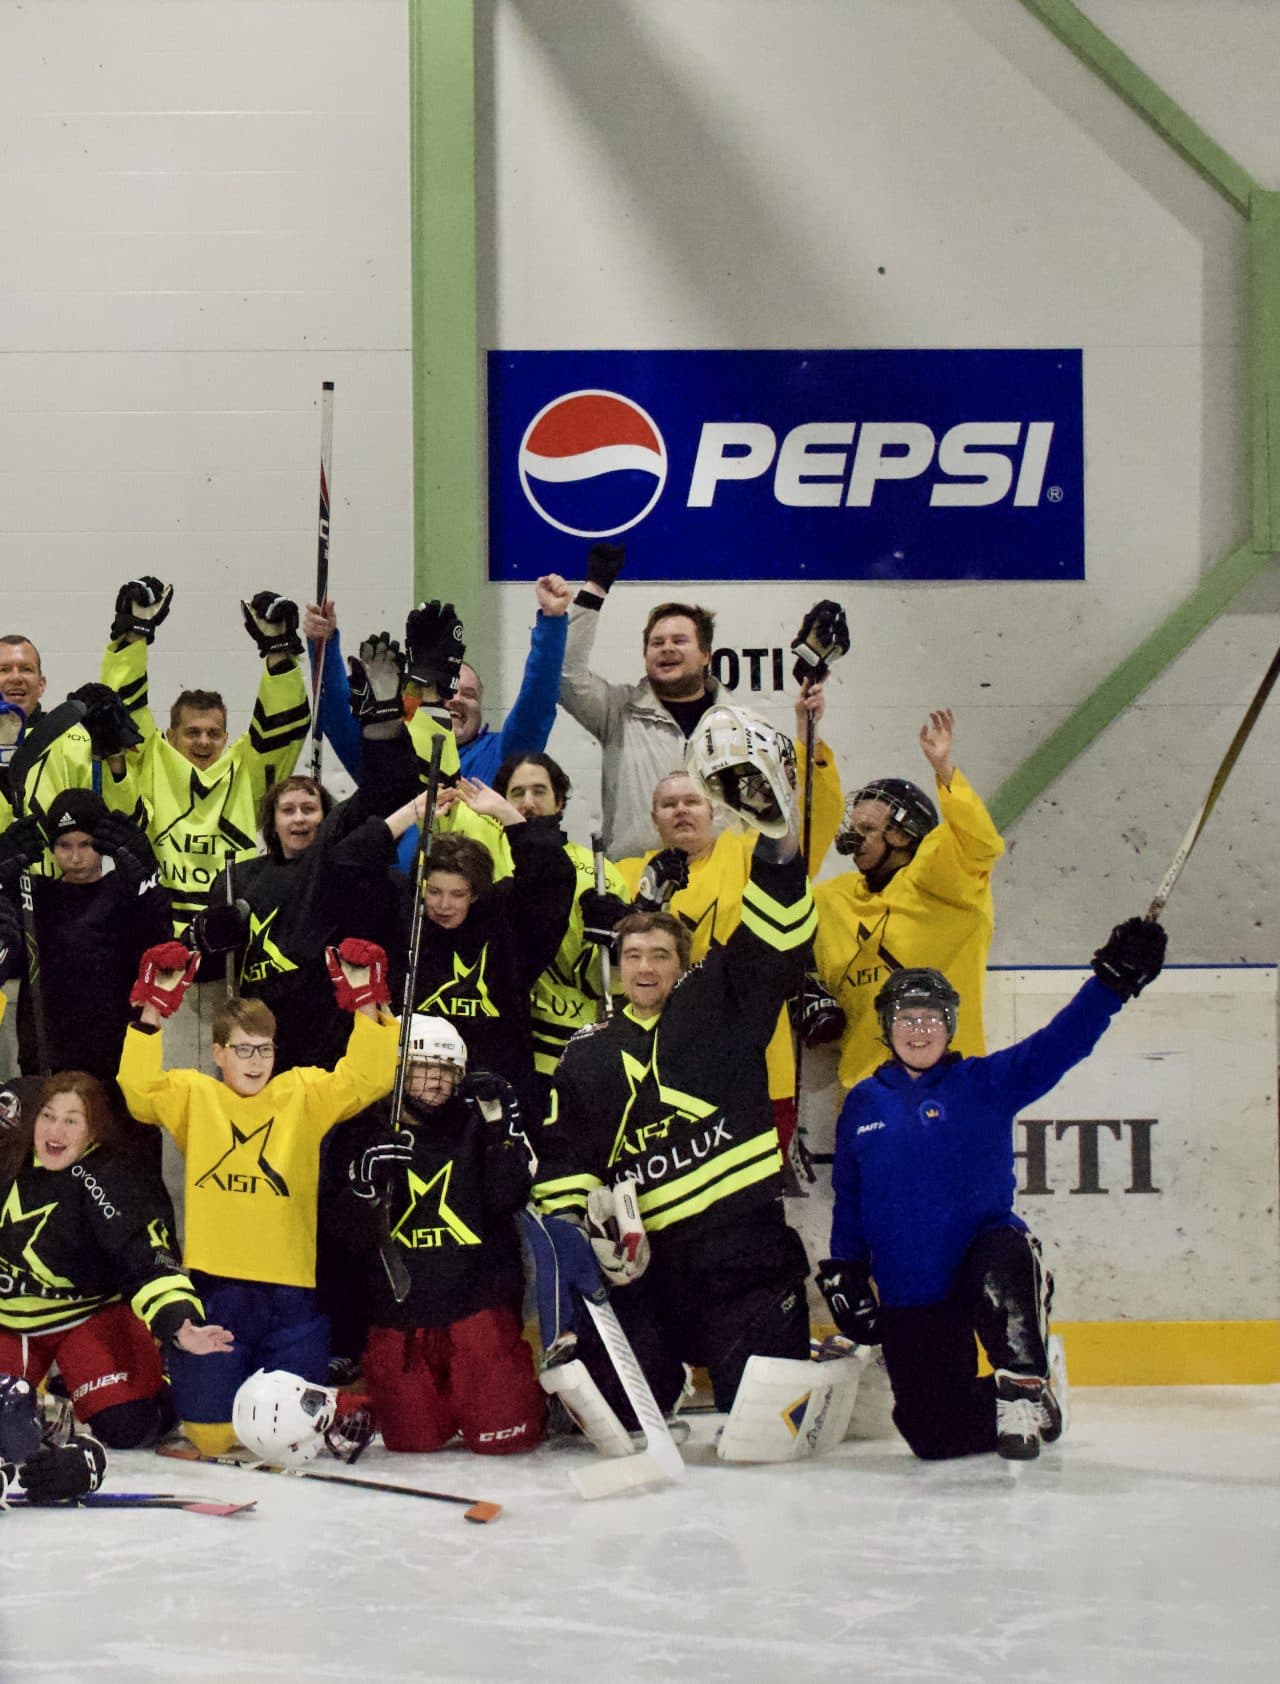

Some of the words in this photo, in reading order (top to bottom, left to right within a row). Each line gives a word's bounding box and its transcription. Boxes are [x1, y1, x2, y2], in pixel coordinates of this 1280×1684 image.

[686, 421, 1055, 508] PEPSI
[72, 1371, 129, 1402] BAUER
[478, 1422, 528, 1443] CCM
